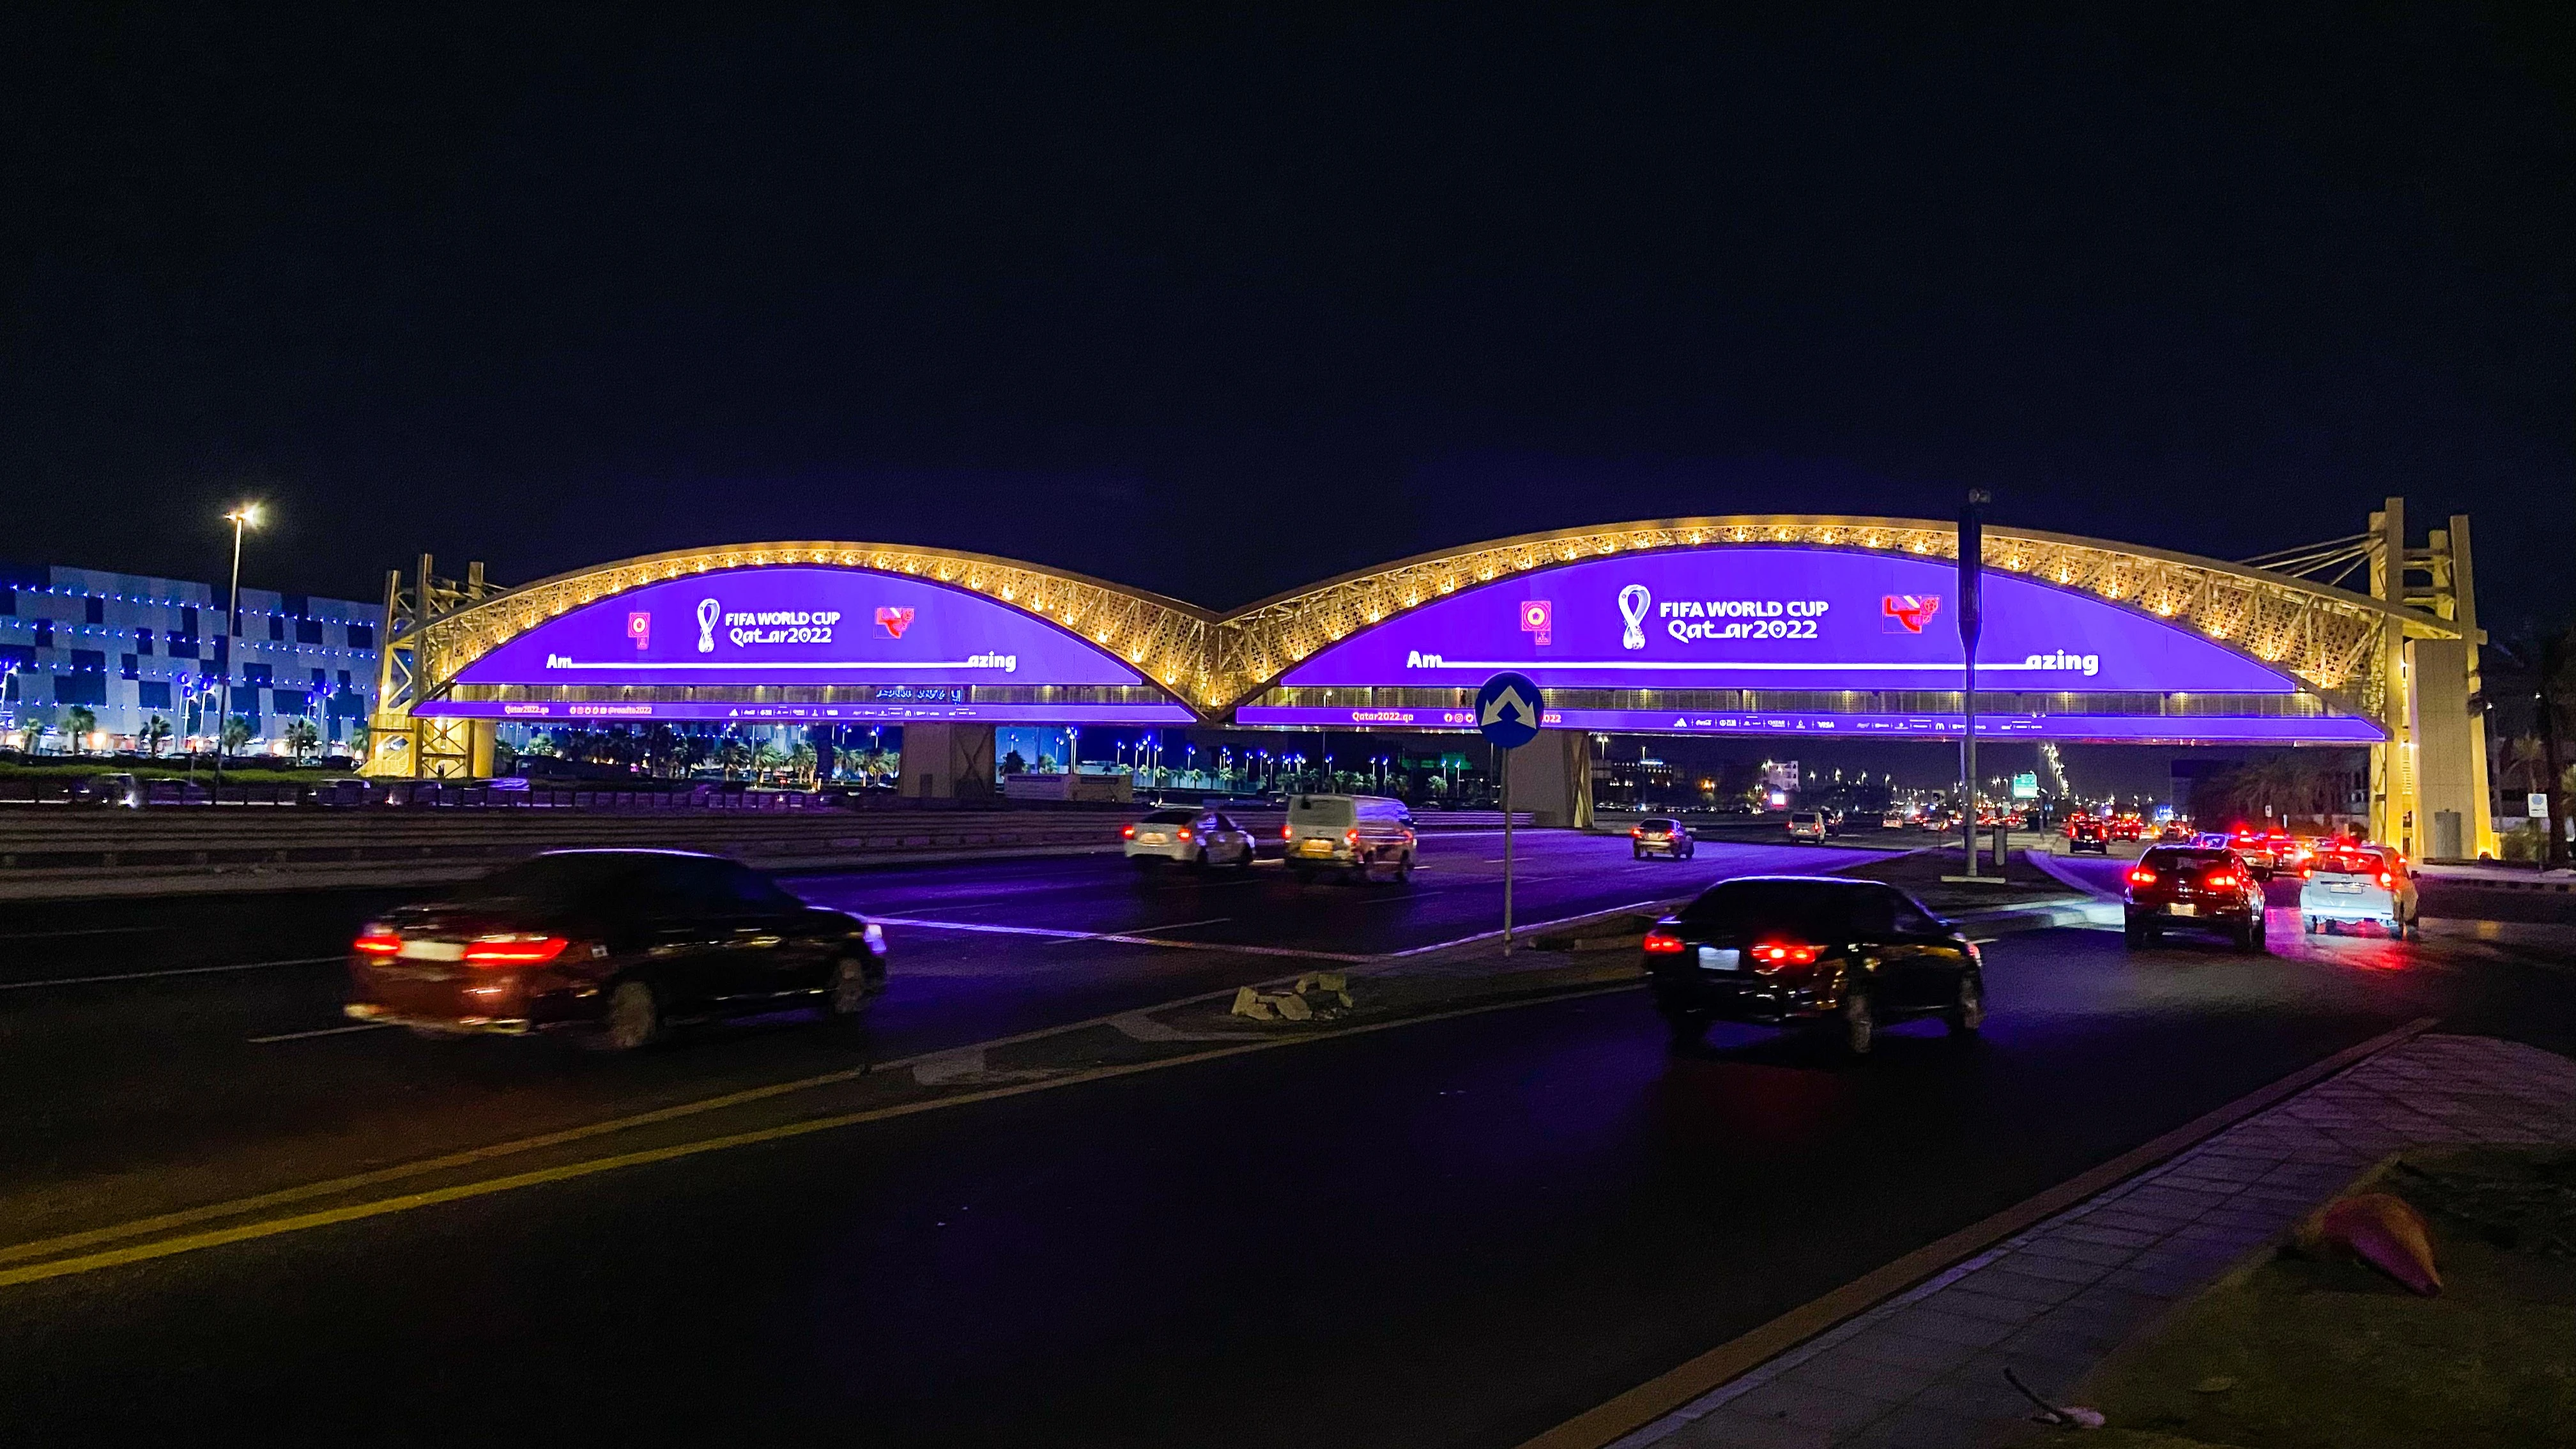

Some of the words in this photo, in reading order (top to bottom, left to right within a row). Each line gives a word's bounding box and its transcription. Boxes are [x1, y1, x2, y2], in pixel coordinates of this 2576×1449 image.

[1660, 601, 1705, 617] FIFA
[1706, 601, 1783, 617] WORLD
[1786, 601, 1829, 617] CUP
[725, 612, 756, 626] FIFA
[757, 611, 810, 625] WORLD
[811, 611, 841, 625] CUP
[730, 627, 832, 648] Qatar2022
[1667, 620, 1818, 644] Qatar2022
[1352, 712, 1414, 723] Qatar2022.qa
